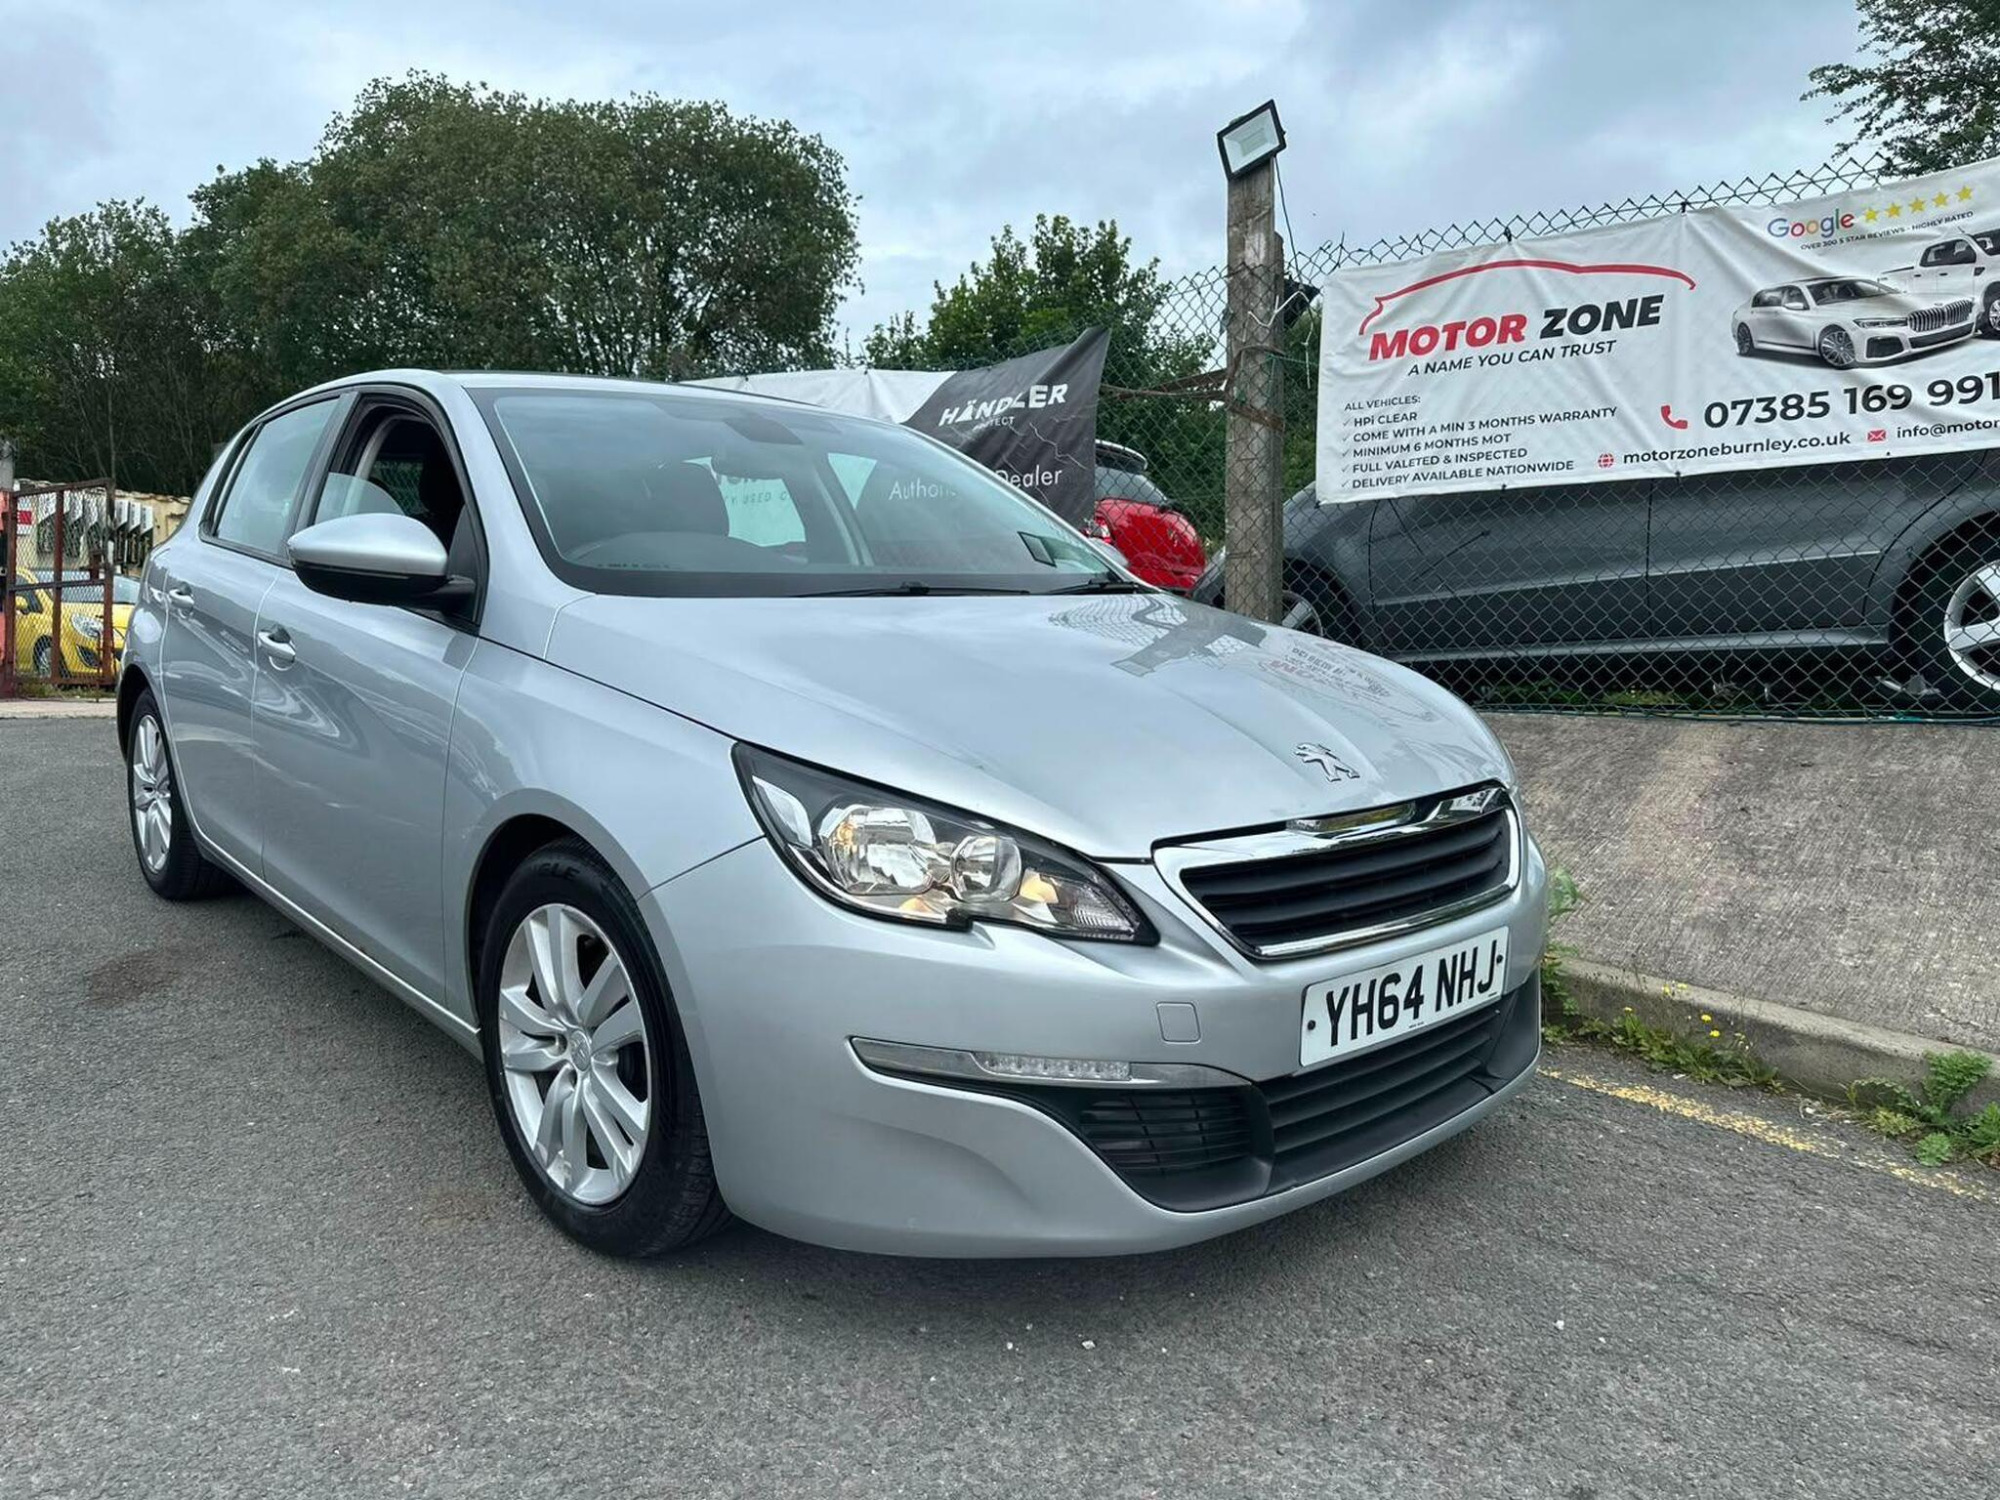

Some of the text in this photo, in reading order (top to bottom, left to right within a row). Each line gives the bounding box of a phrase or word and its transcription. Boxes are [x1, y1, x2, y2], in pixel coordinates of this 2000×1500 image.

[1767, 208, 1855, 239] Google
[1801, 241, 1822, 251] OVER
[1822, 239, 1838, 248] 300
[1846, 234, 1866, 243] STAR
[1867, 227, 1905, 241] REVIEWS
[1912, 218, 1943, 231] HIGHLY
[1944, 210, 1974, 224] RATED
[1369, 294, 1665, 361] MOTOR ZONE
[1408, 340, 1618, 377] A NAME YOU CAN TRUST
[938, 383, 1068, 427] HÄNDLER
[1344, 400, 1365, 412] ALL
[1704, 371, 2000, 429] 07385 169 991
[1353, 406, 1617, 443] COME WITH A MIN 3 MONTHS WARRANTY
[1377, 411, 1417, 425] CLEAR
[1352, 448, 1528, 474] FULL VALETED & INSPECTED
[1353, 433, 1512, 458] MINIMUM 6 MONTHS MOT
[1623, 431, 1851, 465] motorzoneburnley.co.uk
[995, 464, 1062, 488] Dealer
[1352, 460, 1574, 490] DELIVERY AVAILABLE NATIONWIDE
[1326, 940, 1497, 1047] YH64 NHJ
